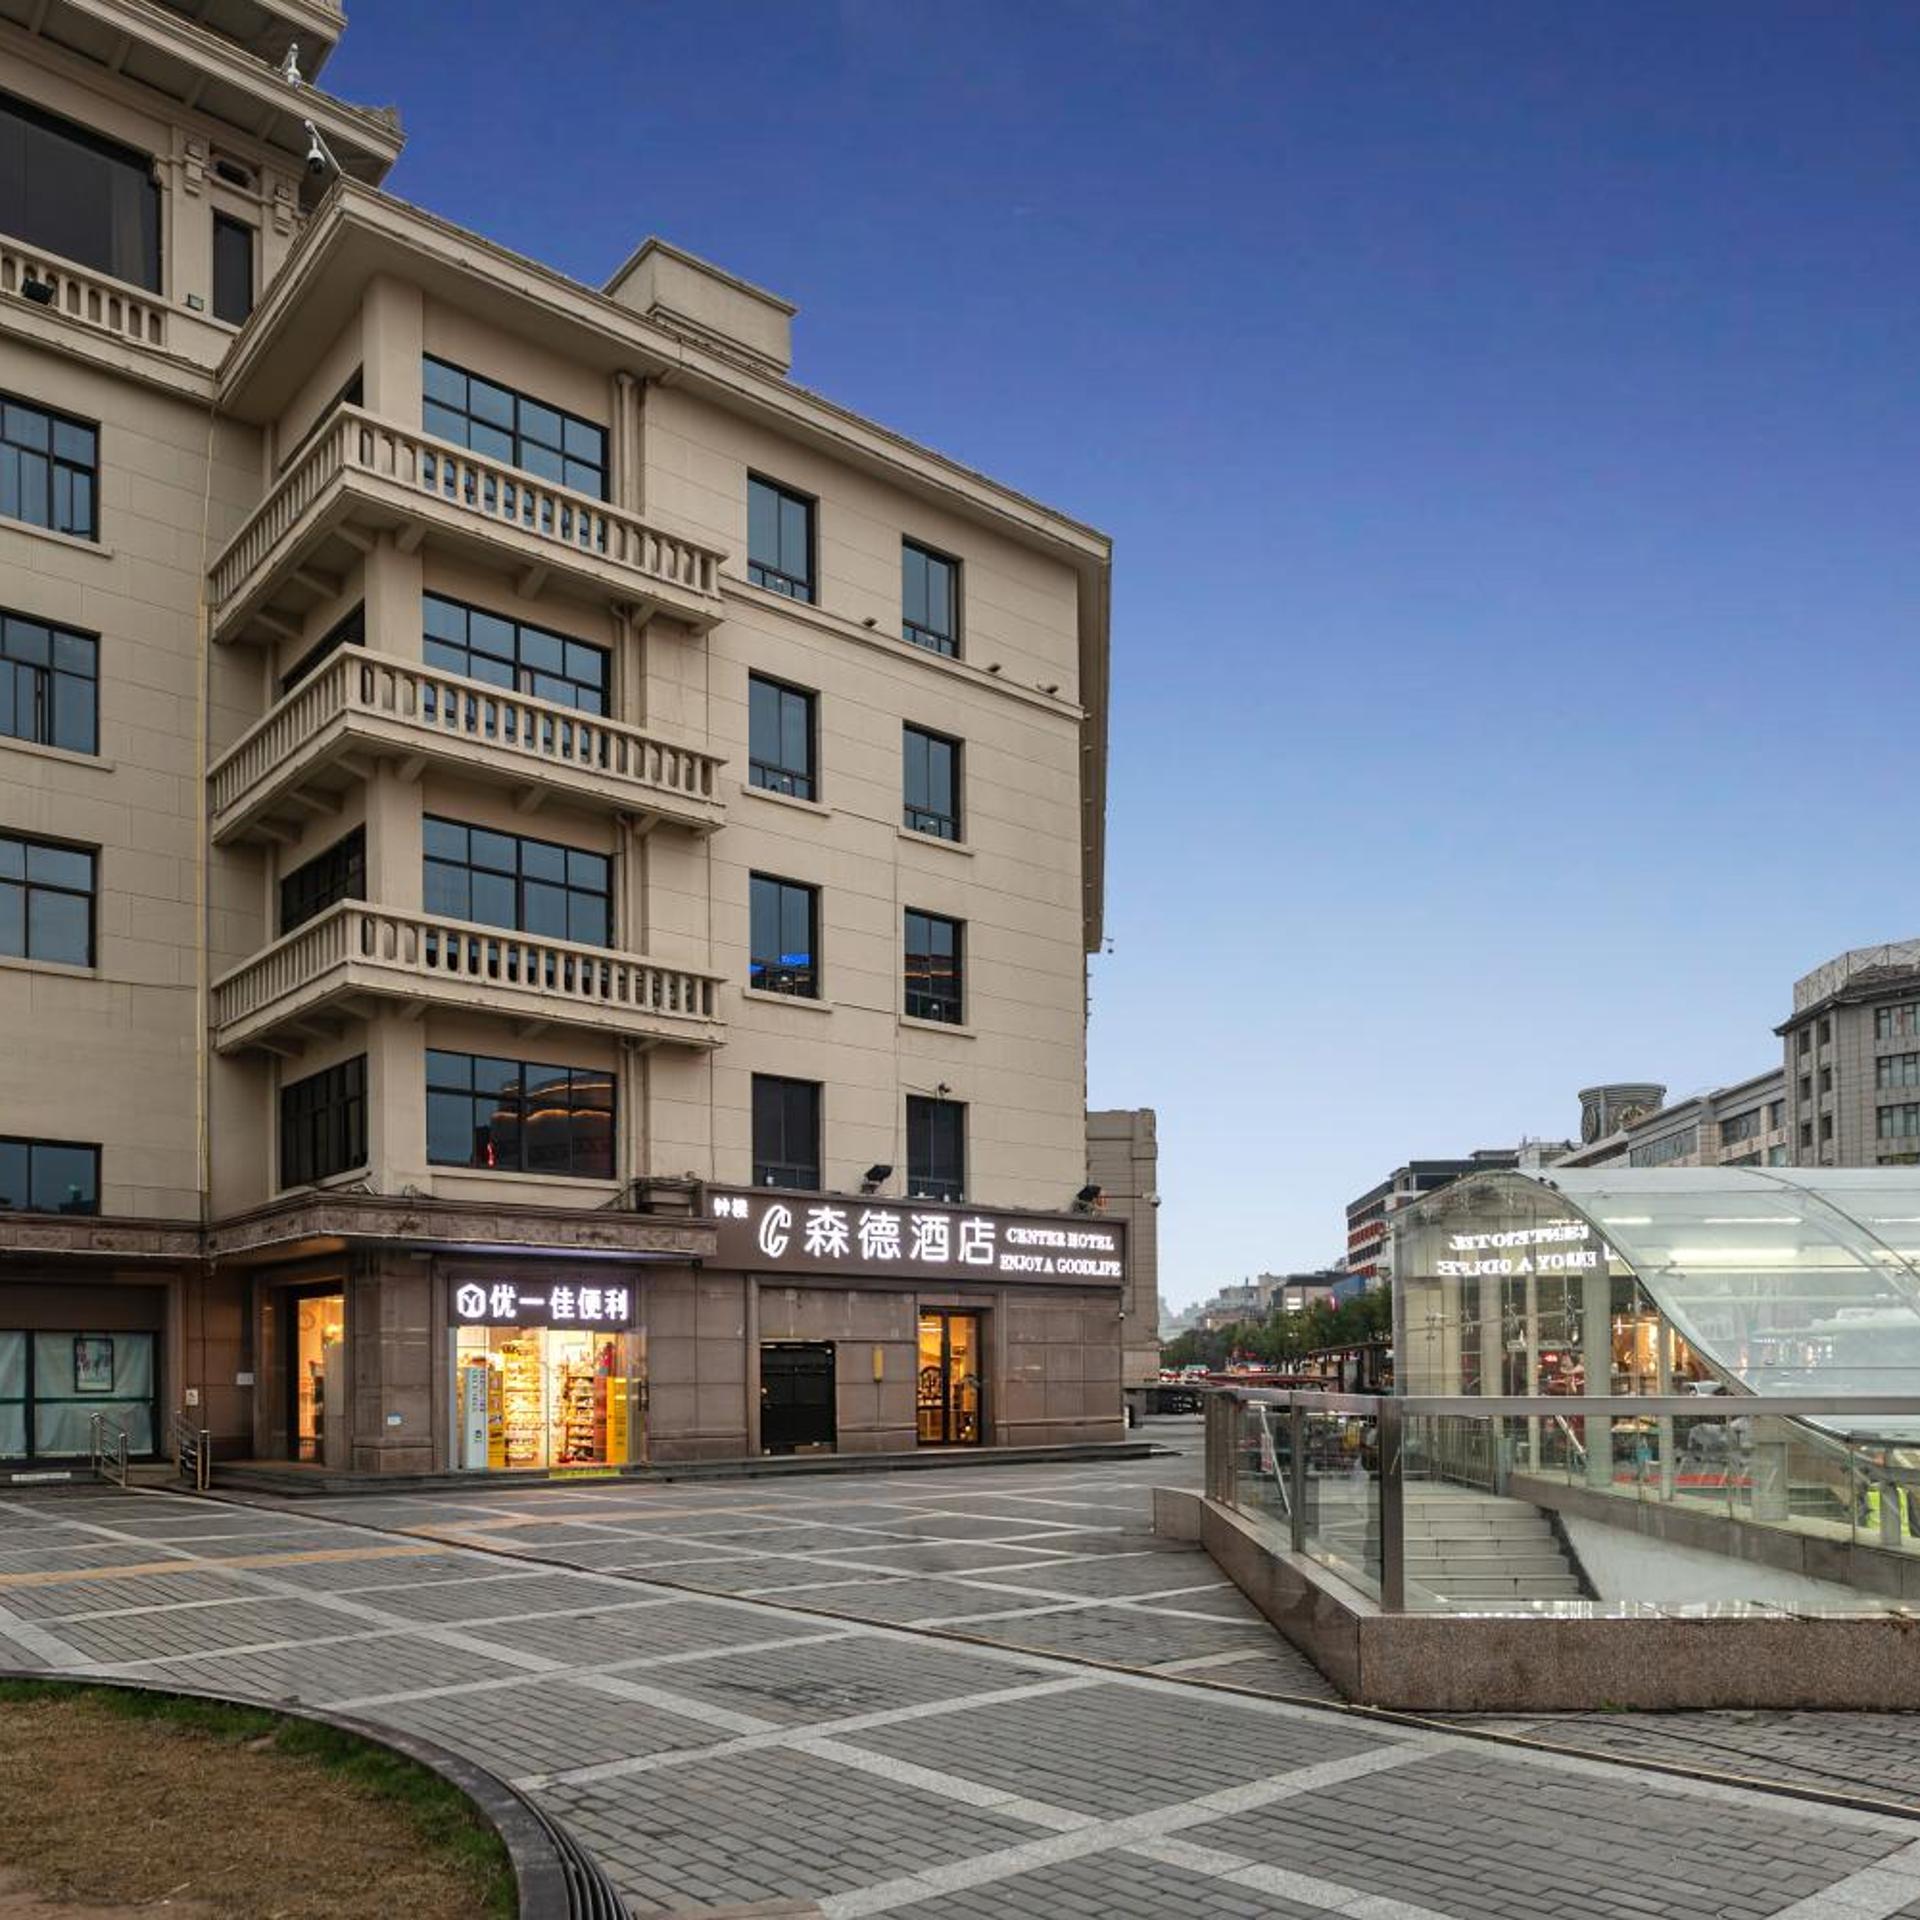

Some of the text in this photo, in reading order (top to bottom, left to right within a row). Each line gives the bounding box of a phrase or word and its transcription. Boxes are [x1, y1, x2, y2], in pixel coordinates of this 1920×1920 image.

[804, 1206, 996, 1265] 森德酒店
[1006, 1227, 1115, 1251] CENTER HOTEL
[490, 1284, 629, 1320] 优一佳便利
